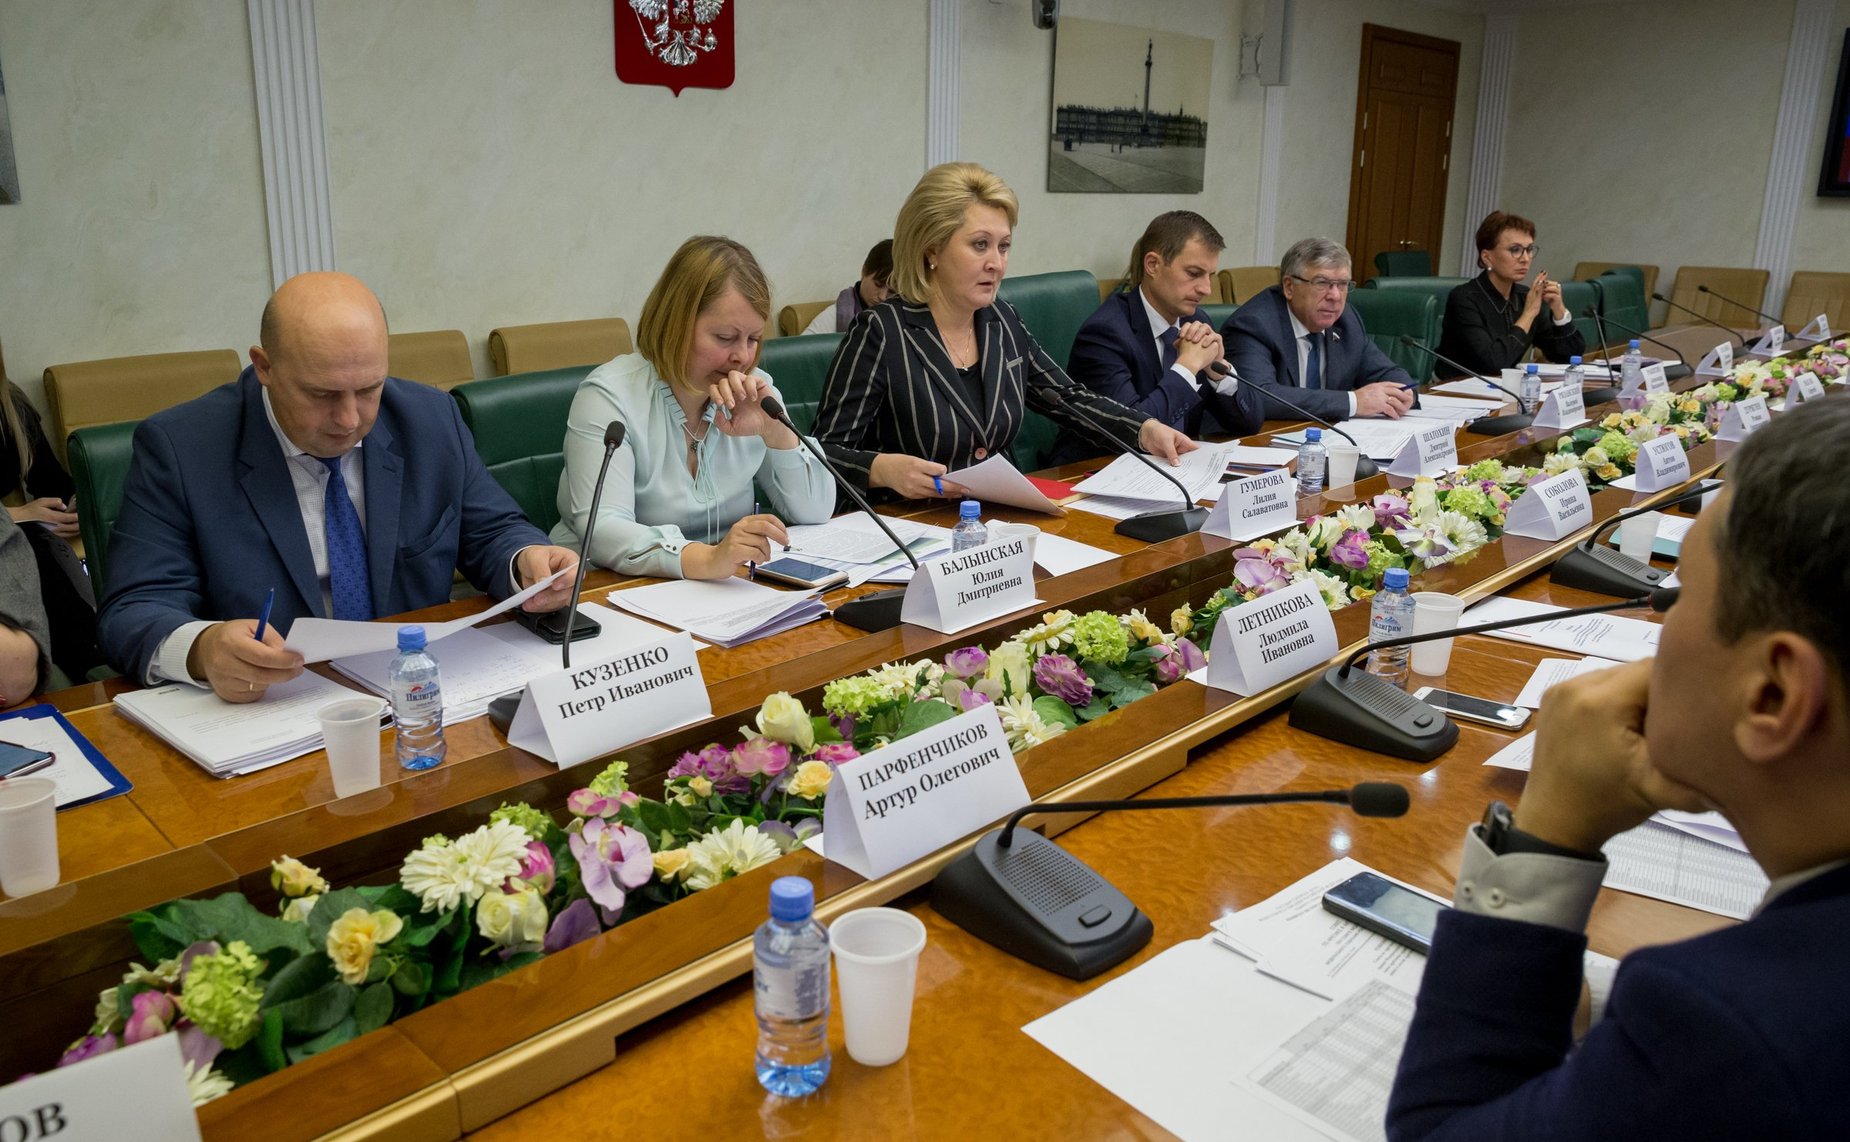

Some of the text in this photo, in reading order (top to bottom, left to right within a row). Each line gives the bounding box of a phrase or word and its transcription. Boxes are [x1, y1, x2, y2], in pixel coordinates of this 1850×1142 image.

[1240, 474, 1284, 494] ГУМЕРОВА
[1252, 493, 1277, 505] Лилия
[1544, 478, 1579, 498] СОКОЛОВА
[1242, 501, 1288, 519] Салаватовна
[940, 540, 1024, 576] БАЛЫНСКАЯ
[957, 575, 1023, 607] Дмитриевна
[972, 568, 1004, 586] Юлия
[1238, 593, 1314, 634] ЛЕТНИКОВА
[1259, 618, 1309, 648] Людмила
[1261, 633, 1315, 664] Ивановна
[570, 646, 669, 690] КУЗЕНКО
[558, 665, 695, 719] Петр Иванович
[858, 723, 988, 791] ПАРФЕНЧИКОВ
[864, 748, 1001, 820] Артур Олегович
